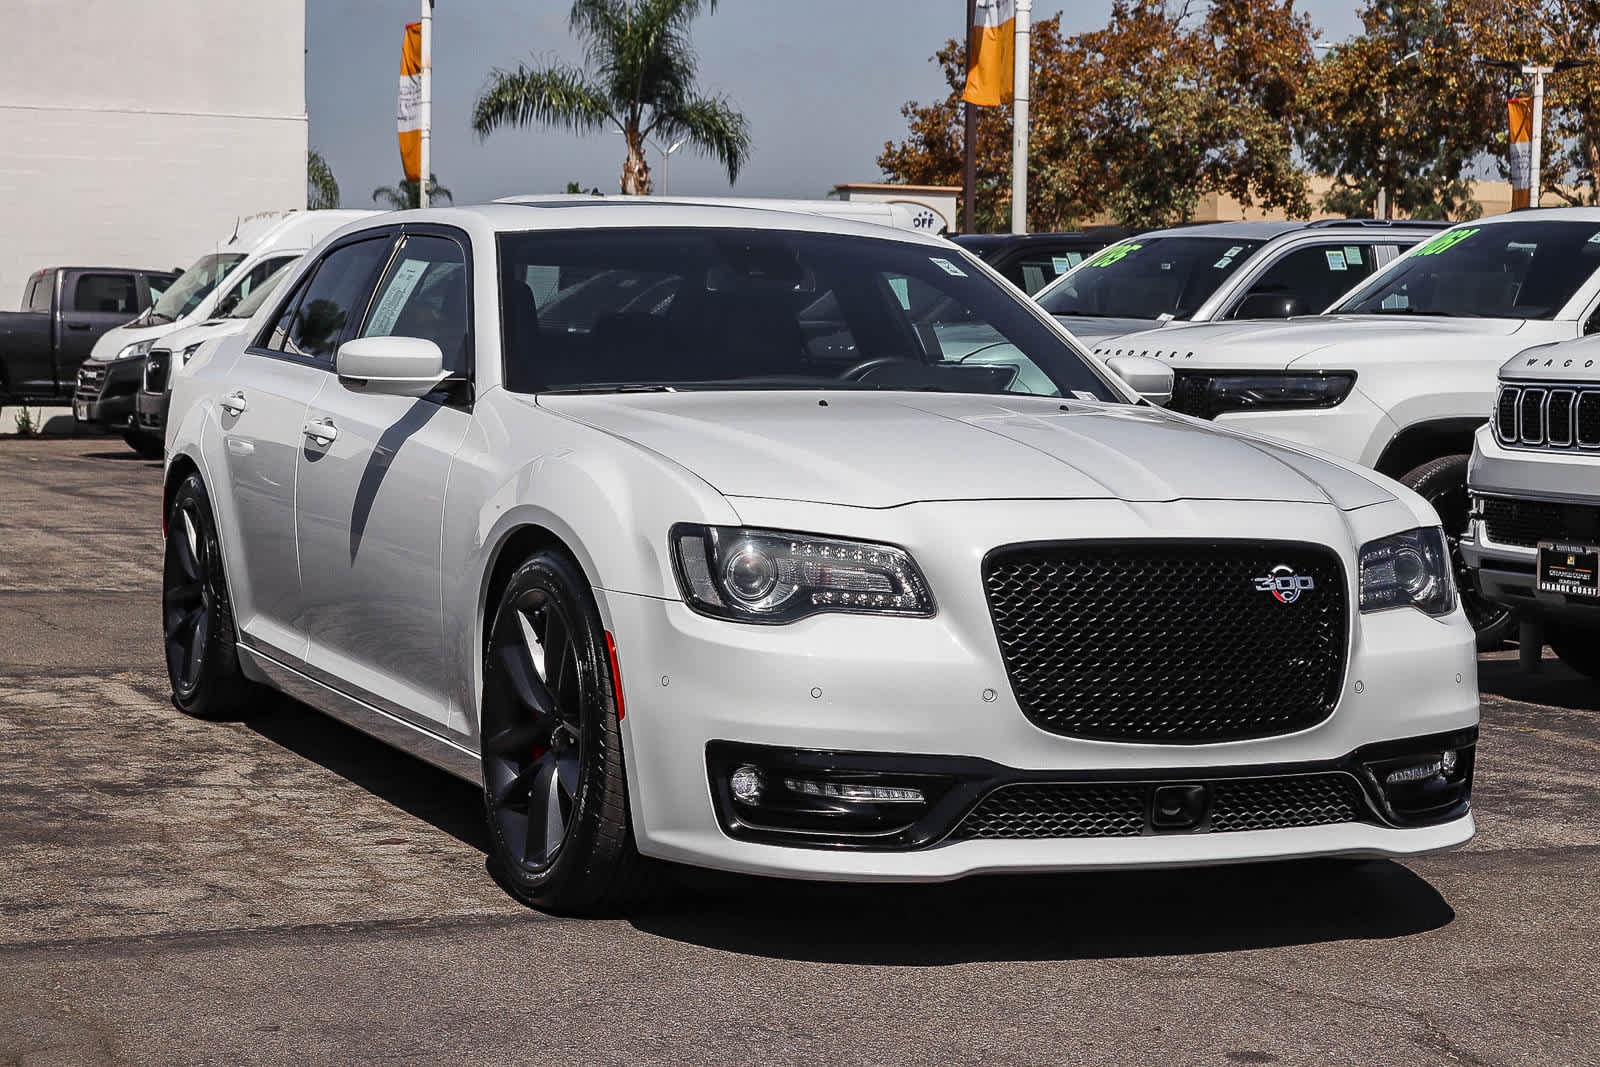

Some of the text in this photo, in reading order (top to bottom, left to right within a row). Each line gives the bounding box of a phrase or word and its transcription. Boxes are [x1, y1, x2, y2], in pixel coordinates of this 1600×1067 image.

[913, 217, 935, 229] OFF
[1093, 348, 1194, 359] WAGONEER
[1254, 574, 1315, 591] 300
